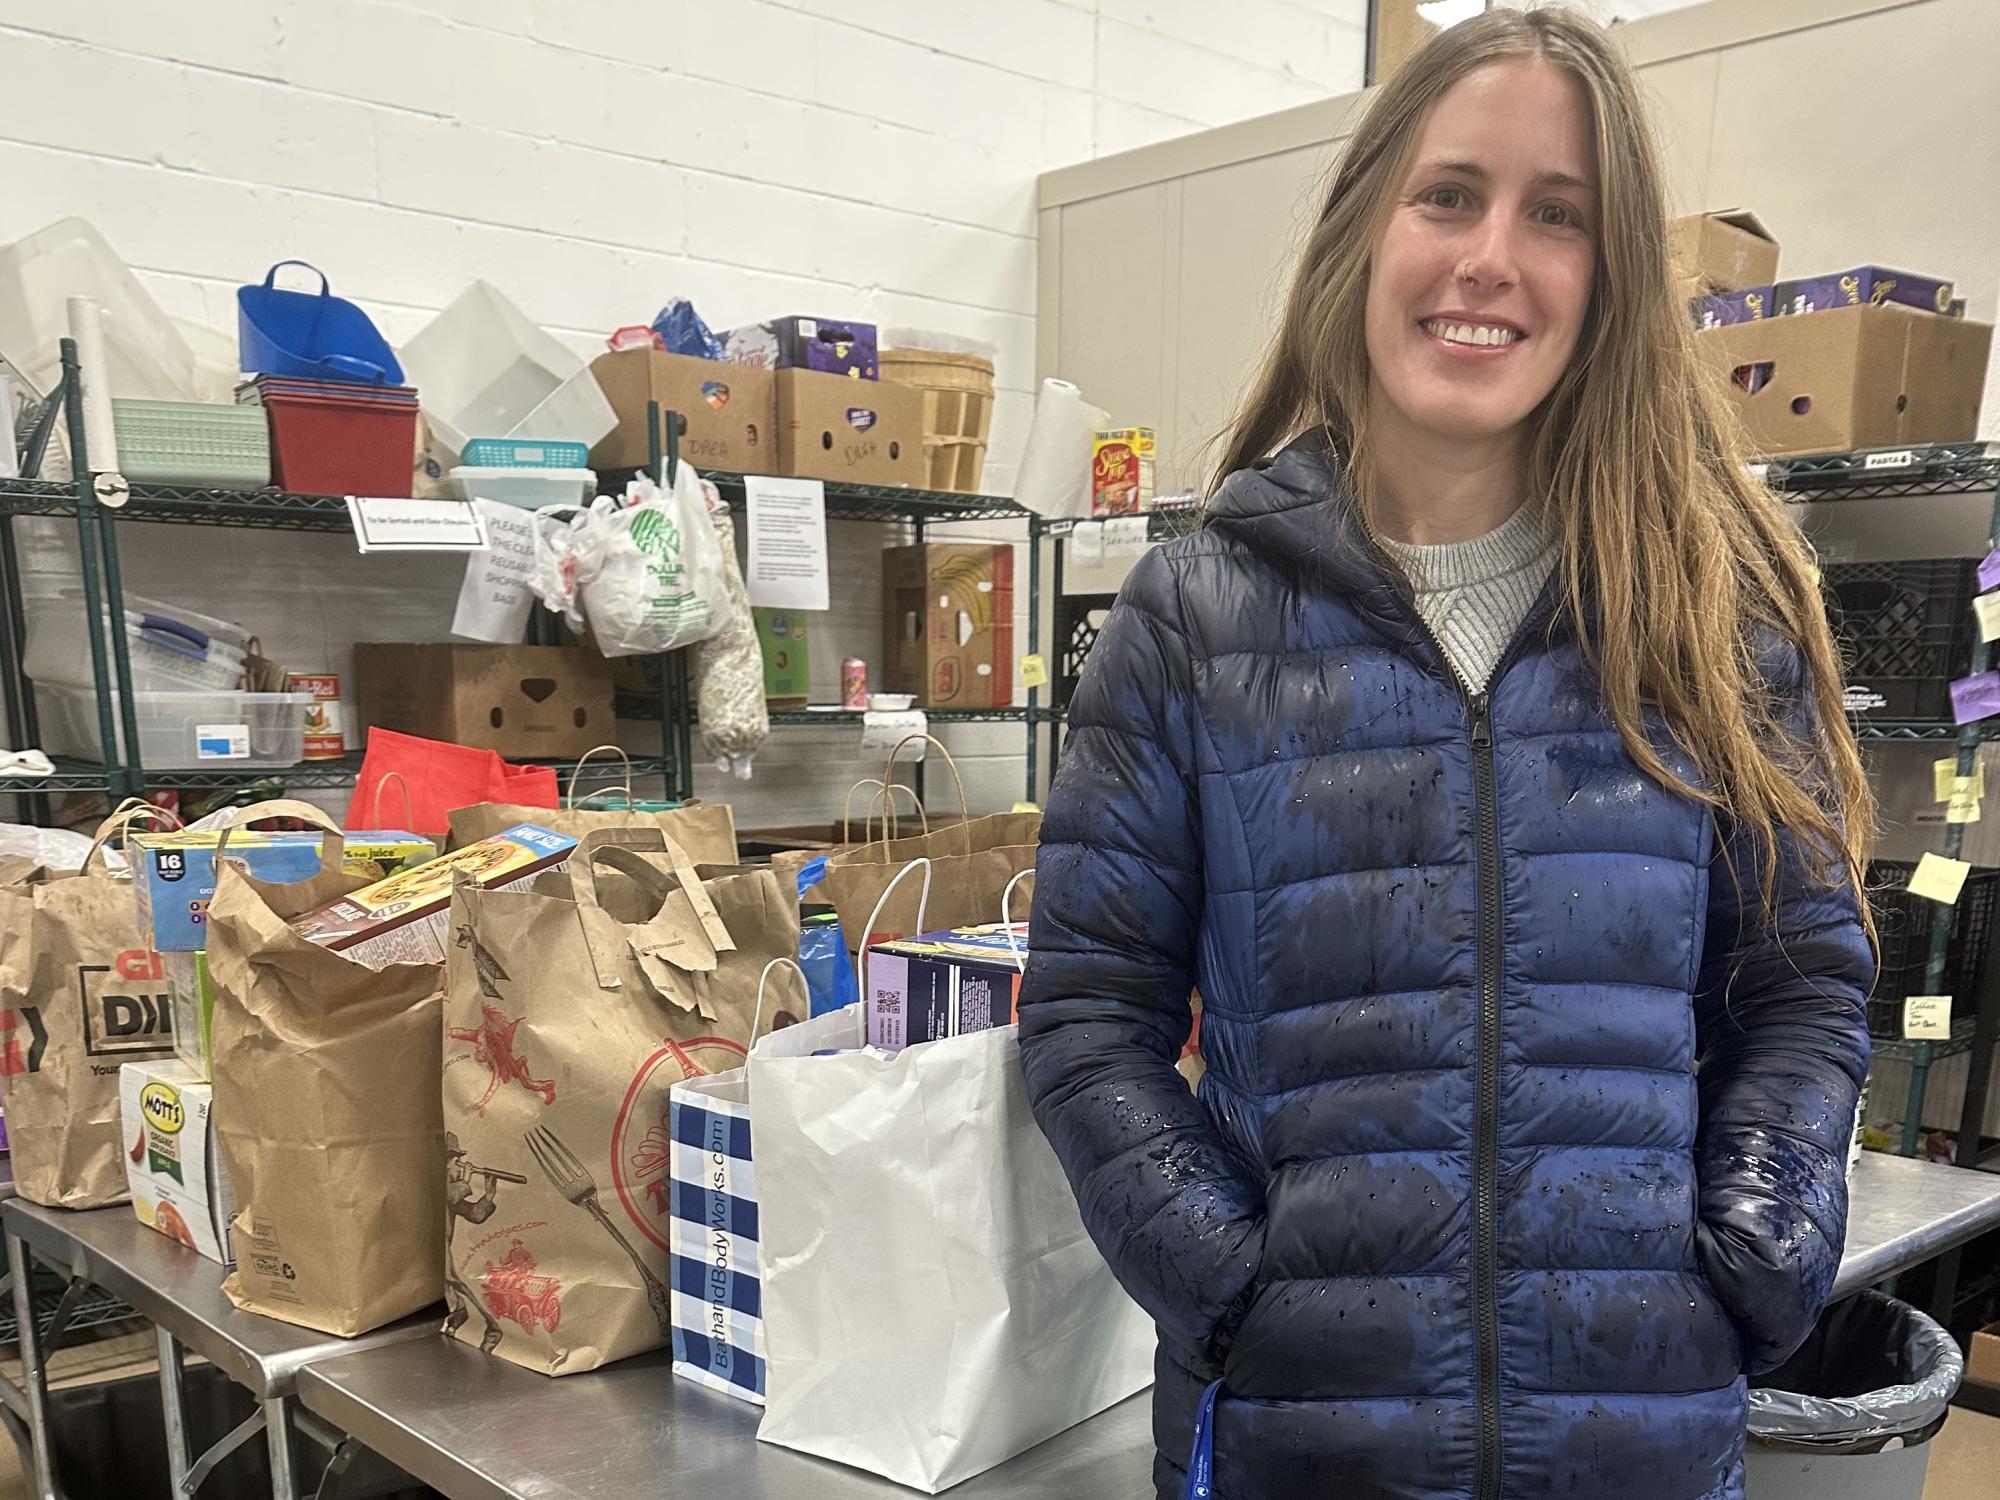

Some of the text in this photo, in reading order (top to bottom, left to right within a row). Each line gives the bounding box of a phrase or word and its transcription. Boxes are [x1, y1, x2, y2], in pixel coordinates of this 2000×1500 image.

[493, 537, 513, 551] THE
[937, 661, 953, 695] Dole
[159, 854, 182, 871] 16
[368, 848, 396, 860] juice
[144, 1094, 180, 1125] MOTT'S
[712, 1119, 730, 1369] BathandBodyWorks.com
